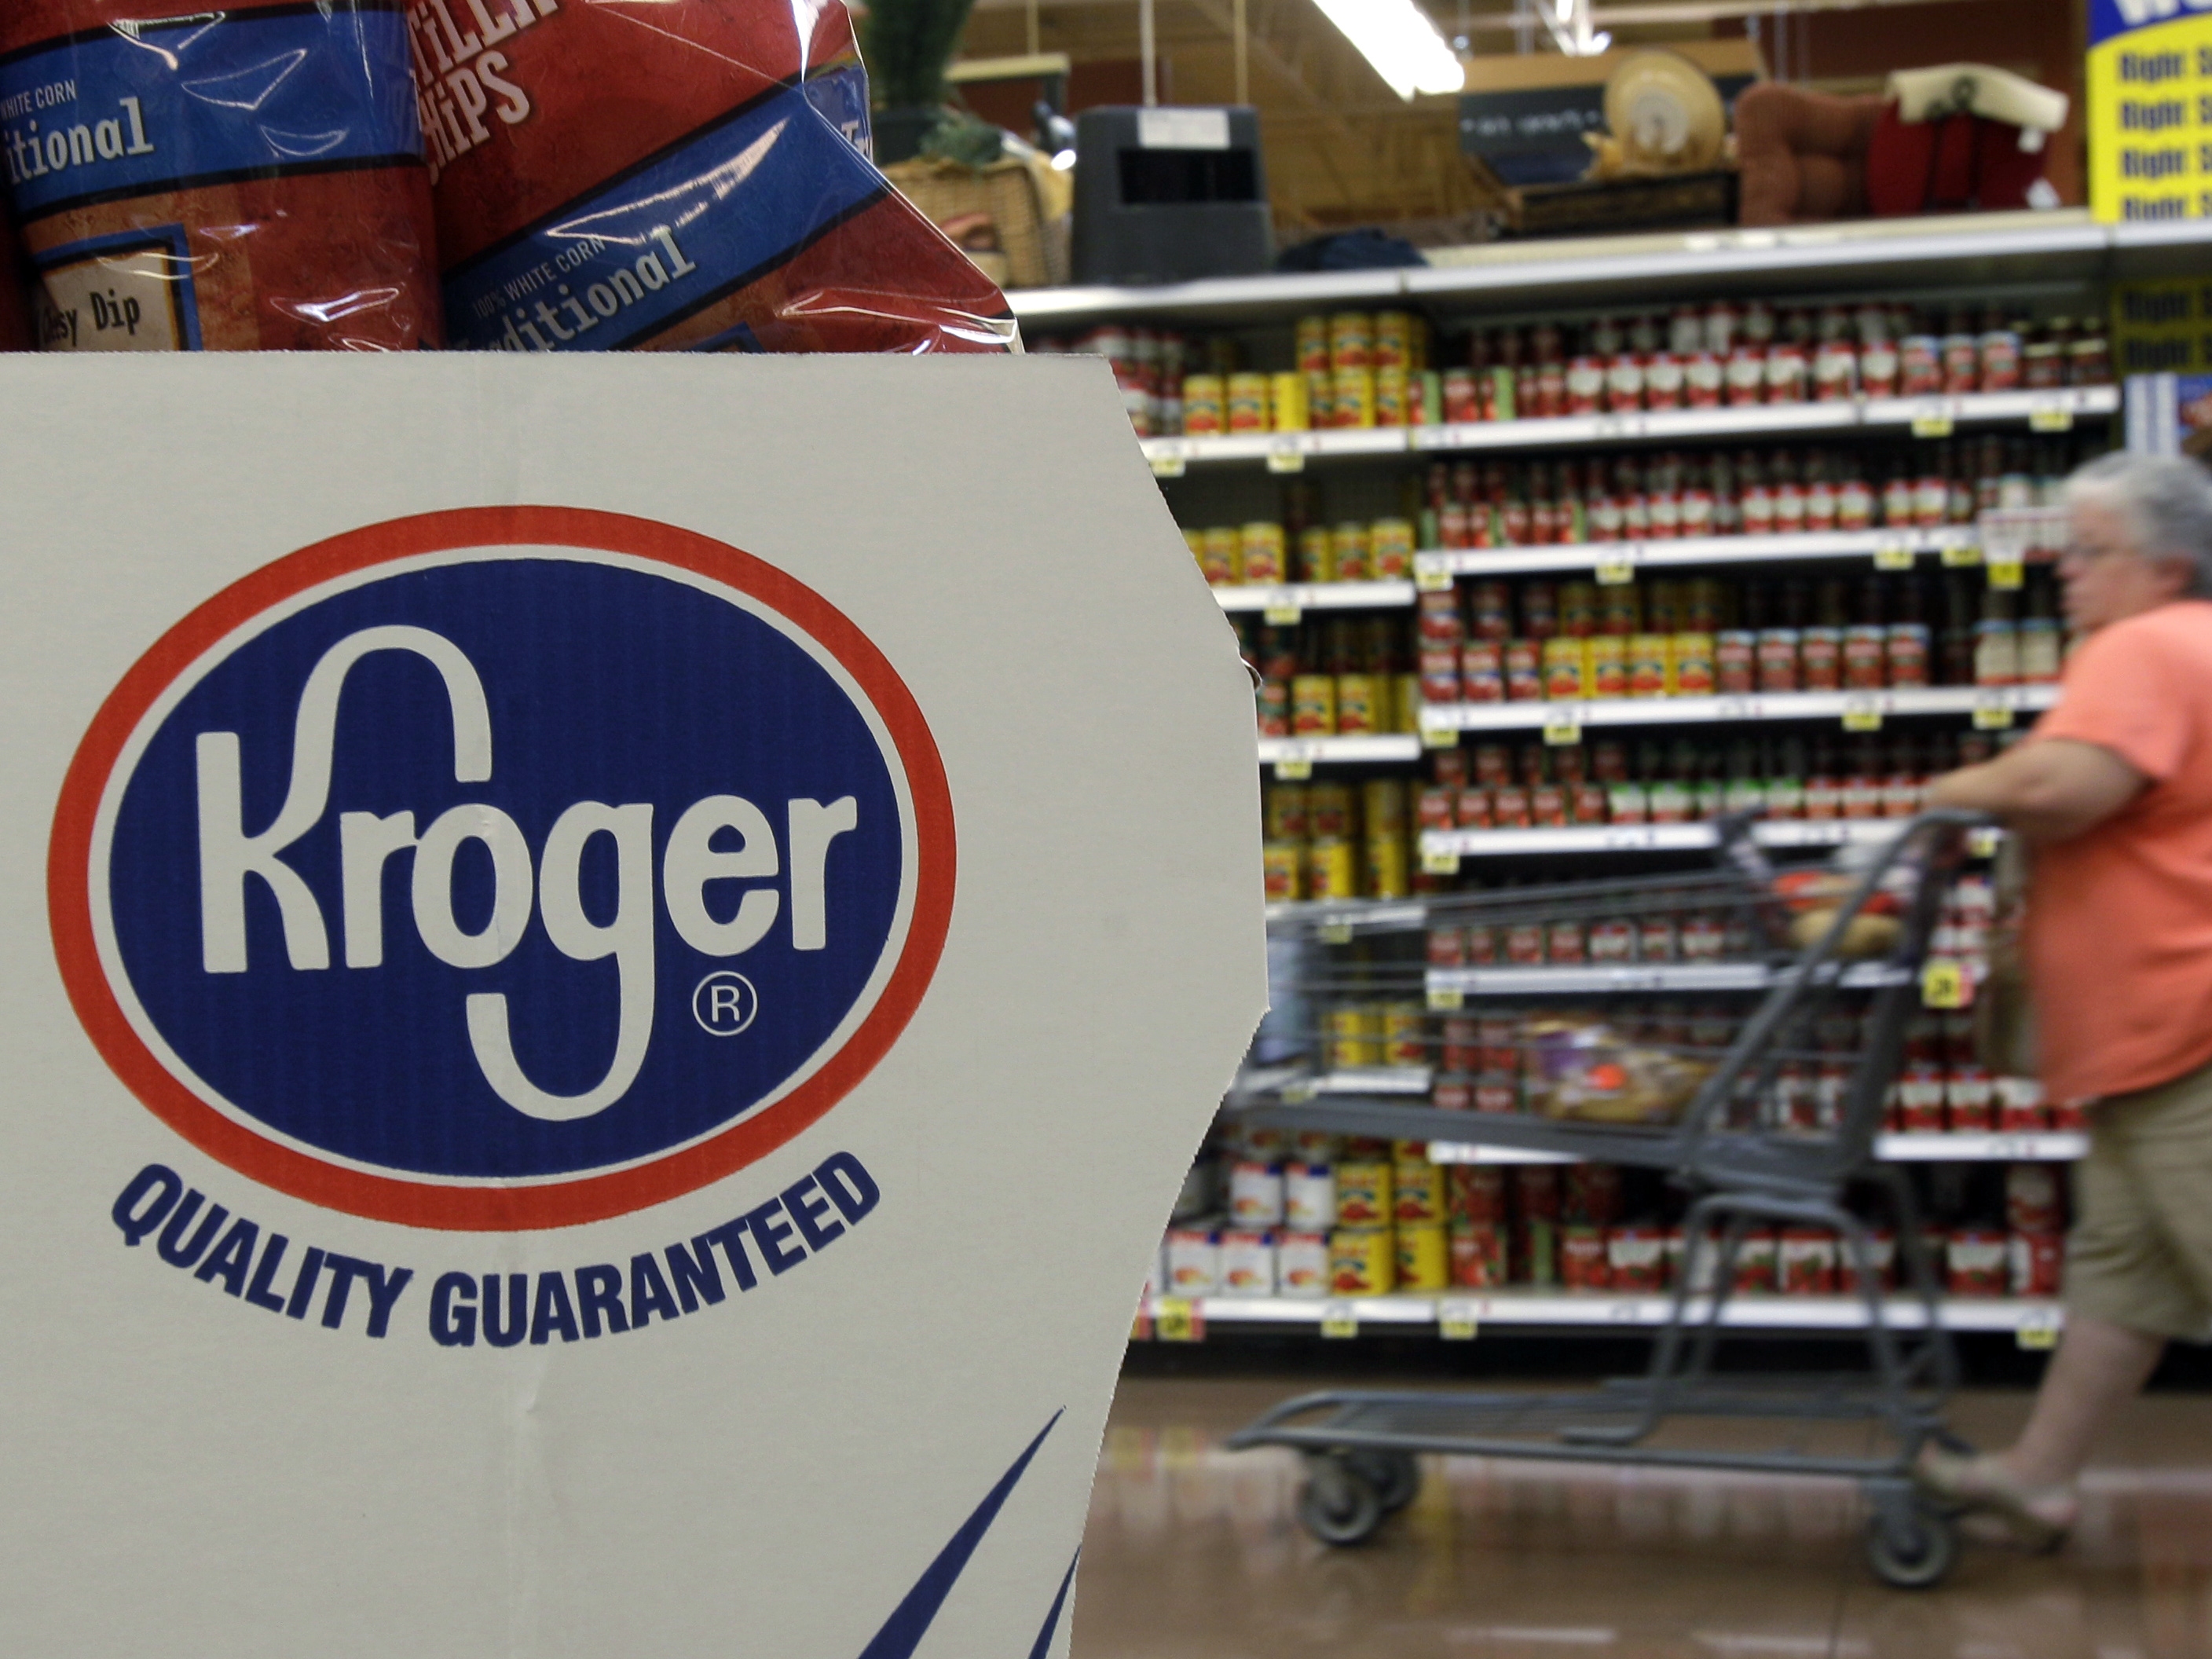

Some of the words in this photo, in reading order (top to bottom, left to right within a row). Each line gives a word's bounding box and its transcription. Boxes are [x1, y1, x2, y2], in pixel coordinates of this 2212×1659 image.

[35, 79, 78, 108] CORN
[90, 287, 141, 335] Dip
[453, 225, 697, 352] ditional
[504, 262, 558, 301] WHITE
[555, 235, 606, 273] CORN
[196, 625, 858, 1121] Kroger
[112, 1163, 414, 1339] QUALITY
[429, 1152, 881, 1348] GUARANTEED
